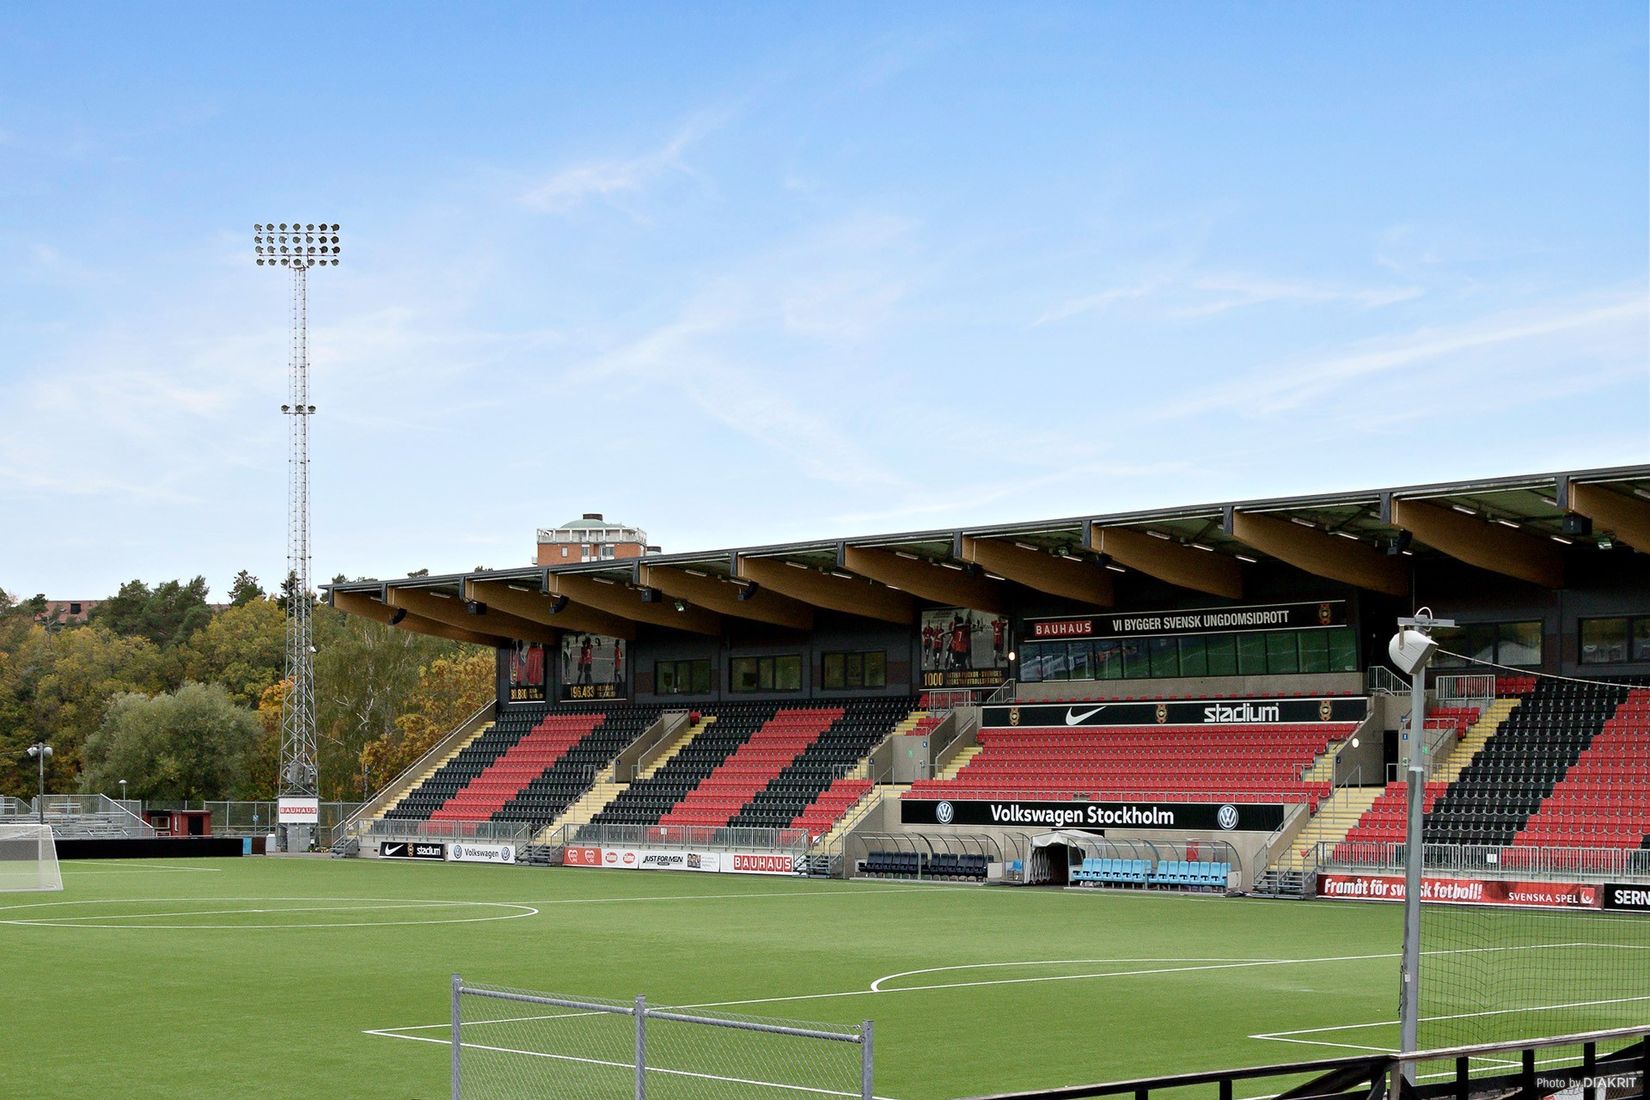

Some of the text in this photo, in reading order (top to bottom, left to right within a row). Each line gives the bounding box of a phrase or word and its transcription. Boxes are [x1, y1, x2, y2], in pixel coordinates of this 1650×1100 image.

[1112, 610, 1290, 632] VI BYGGER SVENSK UNGDOMSIDROTT
[1035, 622, 1092, 635] BAUHAUS
[924, 672, 943, 686] 1000
[1203, 702, 1280, 723] stadium
[991, 804, 1174, 827] Volkswagen Stockholm
[416, 846, 441, 856] stadium
[464, 848, 499, 860] Volkswagen
[643, 855, 657, 864] JUST
[657, 855, 669, 863] FOR
[735, 856, 792, 870] BAUHAUS
[1324, 878, 1368, 894] Framåt
[1369, 879, 1389, 896] för
[1434, 880, 1483, 900] fotboll!
[1508, 892, 1578, 904] SVENSKA SPEL
